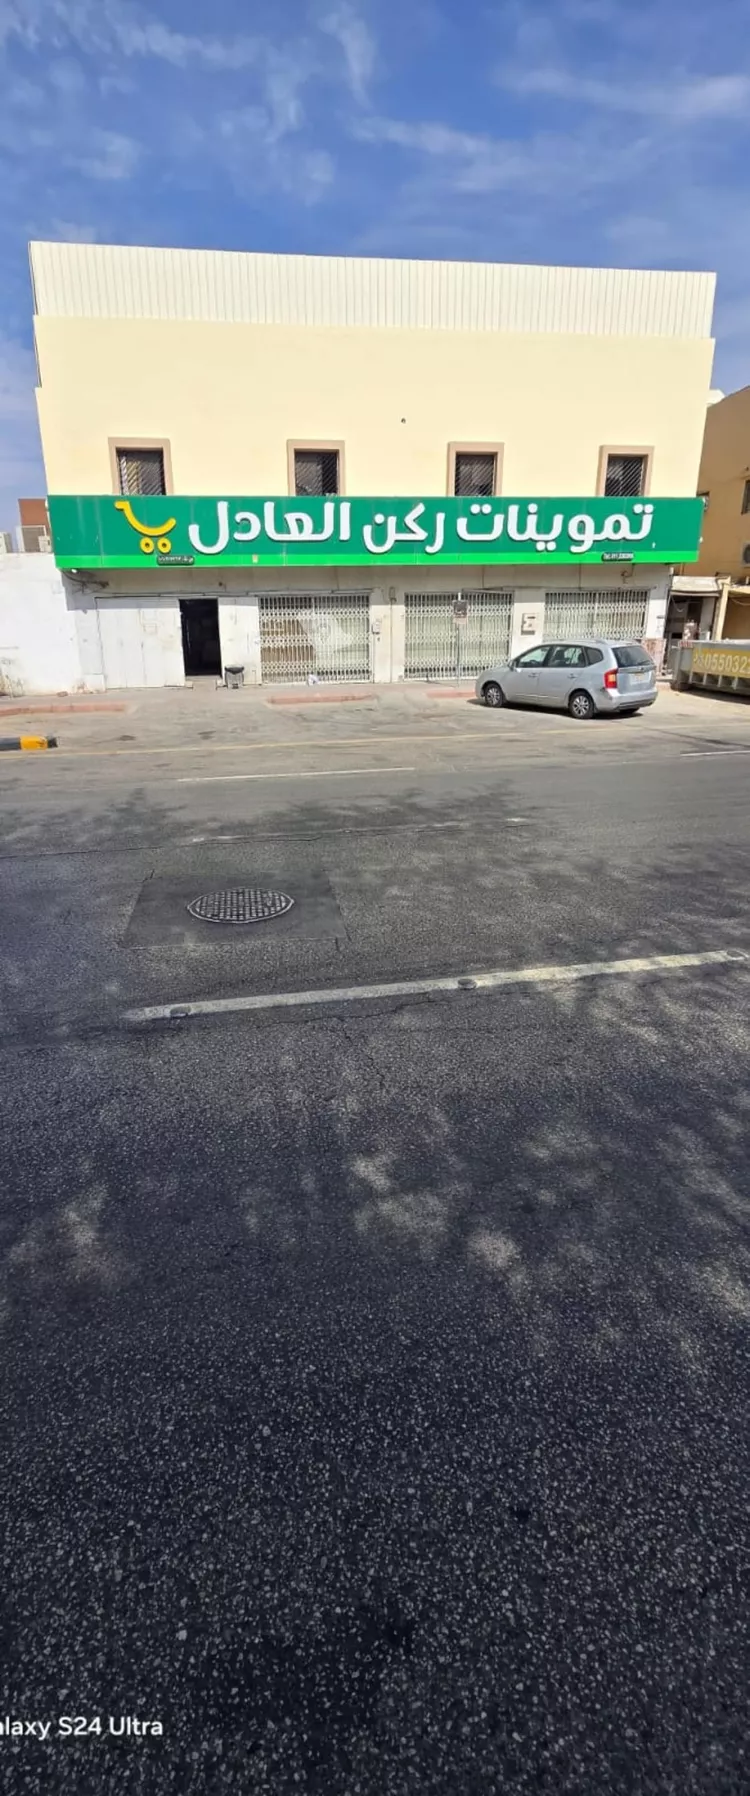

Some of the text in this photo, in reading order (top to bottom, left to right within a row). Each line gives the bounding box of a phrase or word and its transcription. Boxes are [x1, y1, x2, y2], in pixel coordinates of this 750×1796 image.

[188, 501, 654, 554] تموينات ركن العادل
